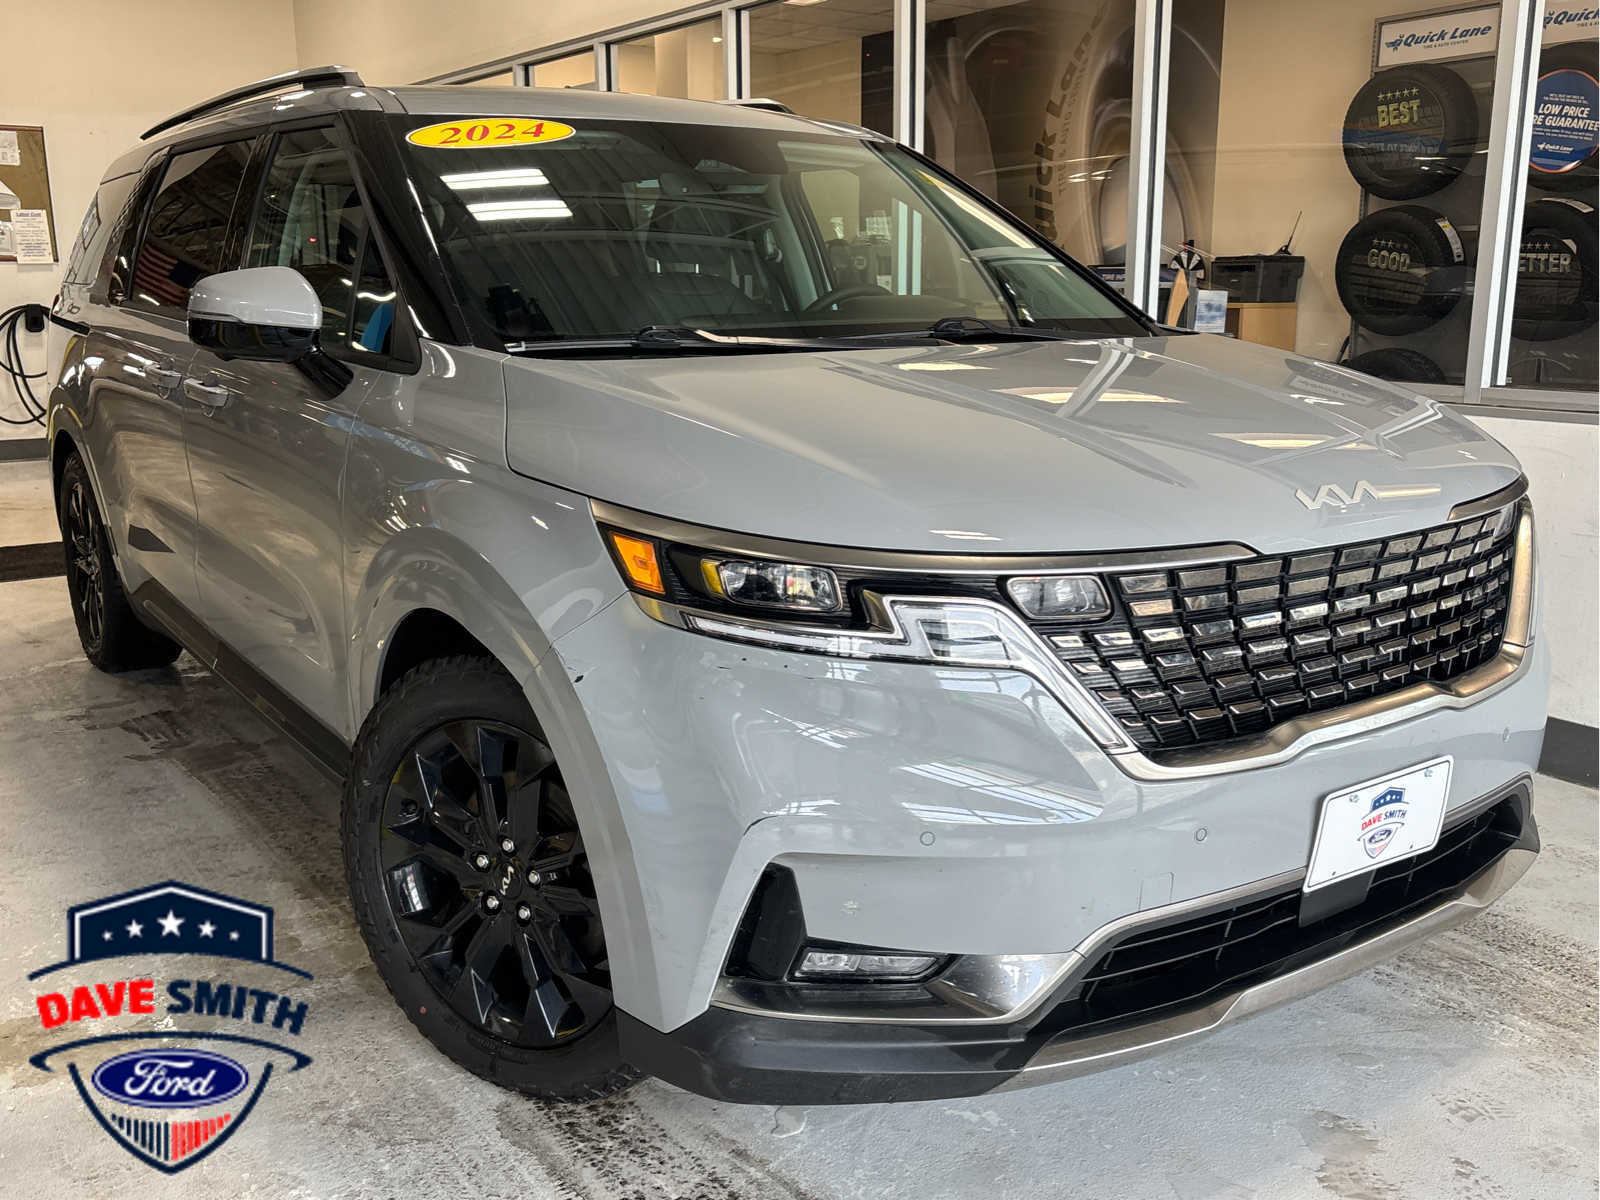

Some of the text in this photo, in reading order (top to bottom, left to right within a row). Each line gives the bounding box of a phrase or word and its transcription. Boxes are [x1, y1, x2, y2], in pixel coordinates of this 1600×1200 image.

[1404, 25, 1492, 47] Quick Lane
[1377, 99, 1420, 128] BEST
[1538, 103, 1590, 118] LOW PRICE
[440, 122, 545, 144] 2024
[1545, 115, 1599, 131] GUARANTEE
[1368, 248, 1410, 272] GOOD
[1519, 253, 1571, 273] ETTER
[1361, 809, 1408, 831] DAVE SMITH
